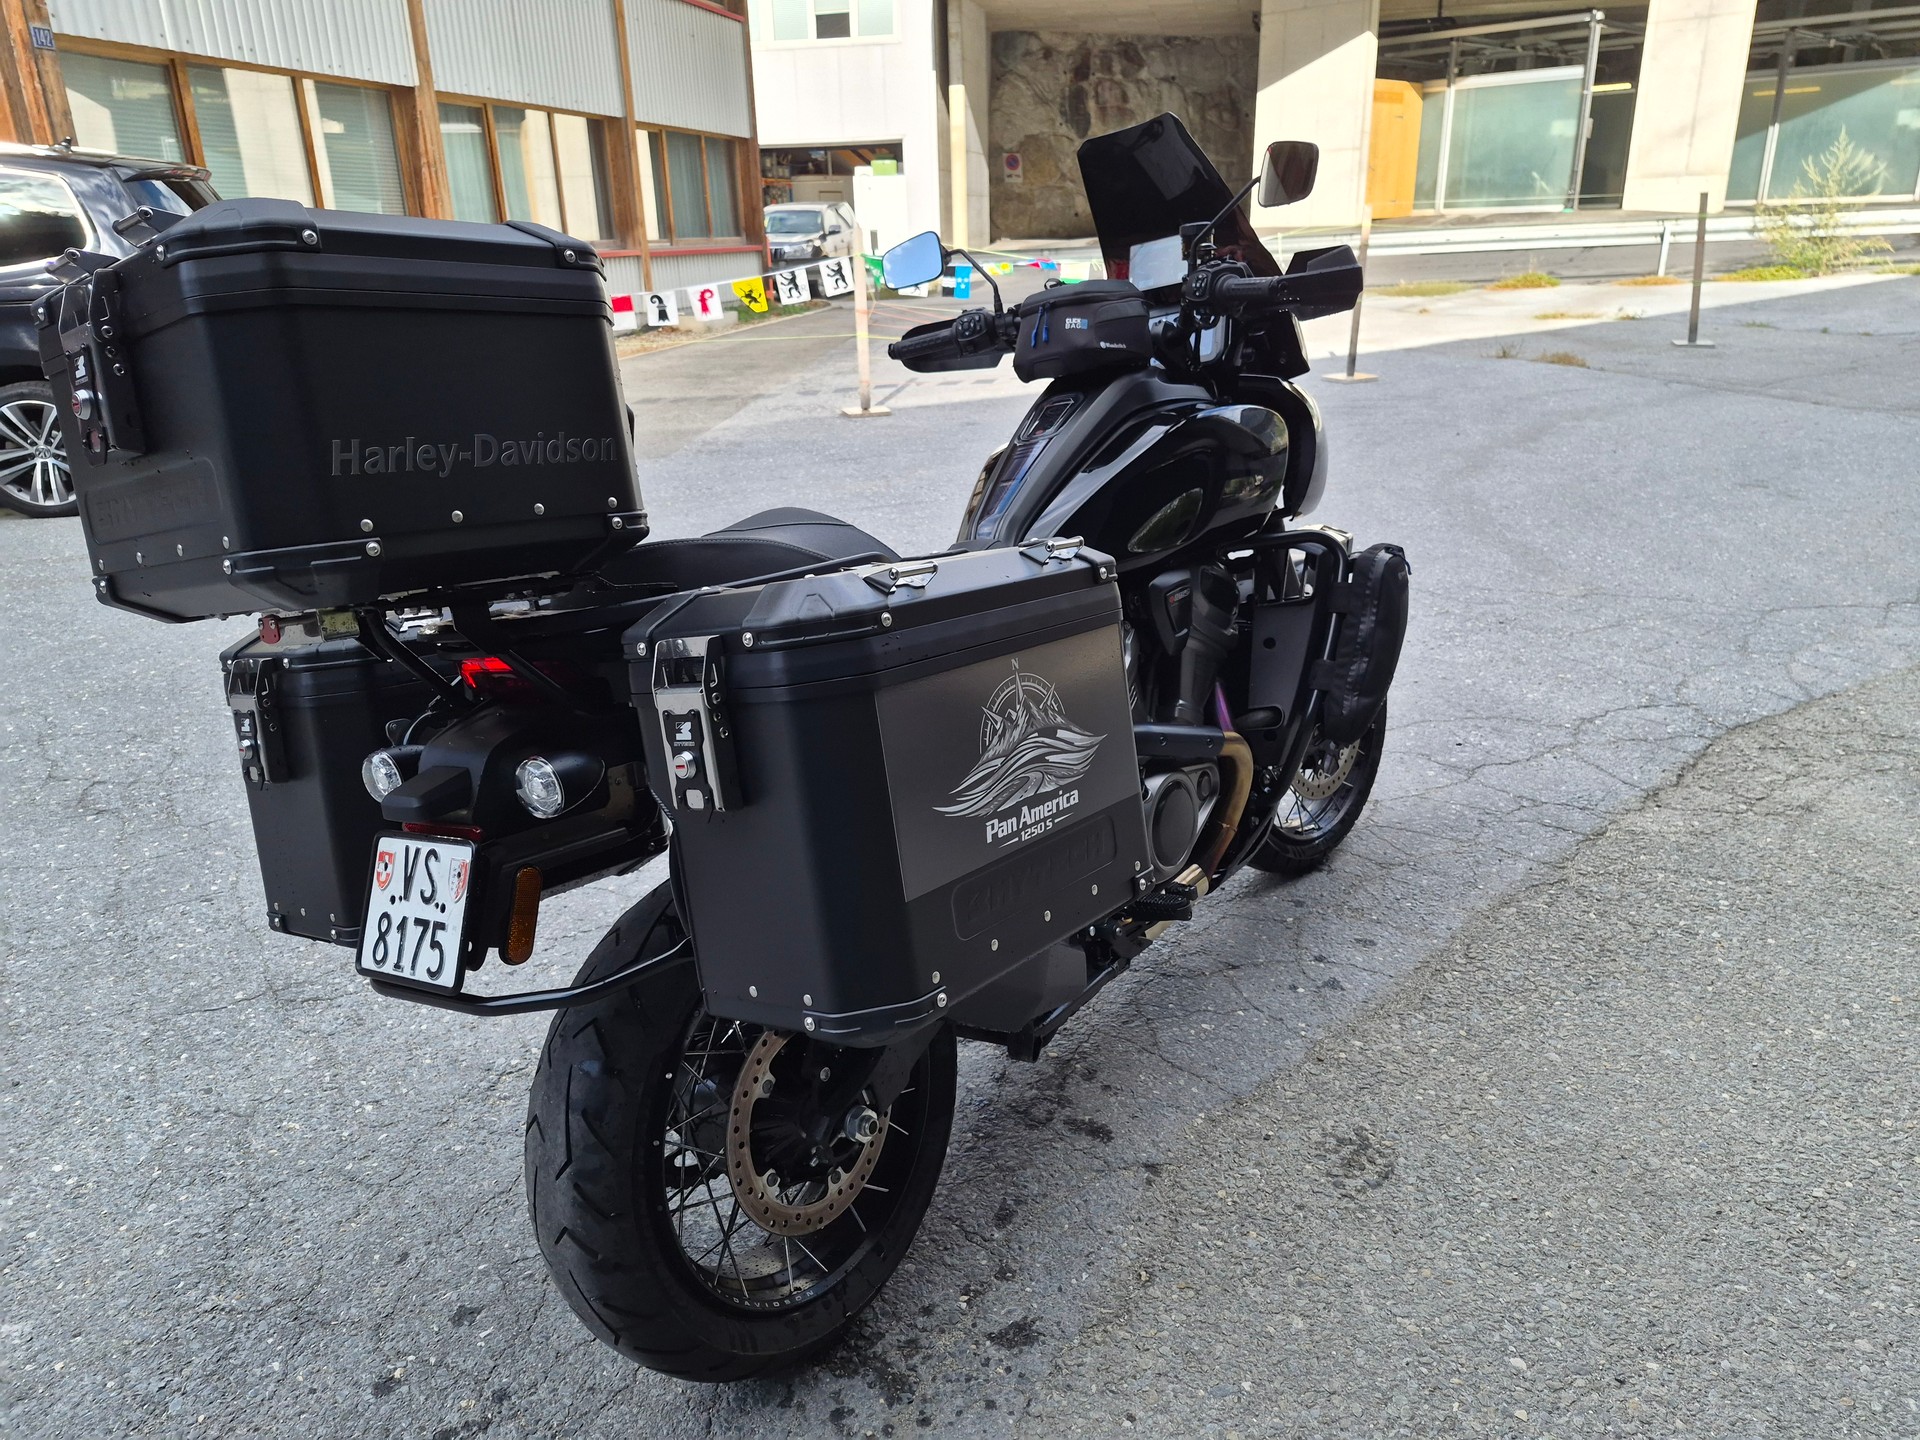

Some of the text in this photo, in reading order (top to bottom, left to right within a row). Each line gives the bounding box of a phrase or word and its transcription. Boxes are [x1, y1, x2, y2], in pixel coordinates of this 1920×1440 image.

[34, 29, 52, 47] 142
[331, 431, 617, 478] Harley-Davidson
[1011, 657, 1019, 670] N
[985, 789, 1079, 844] Pan America
[1020, 818, 1053, 841] 1250 S
[403, 845, 441, 905] VS
[373, 911, 447, 981] 8175
